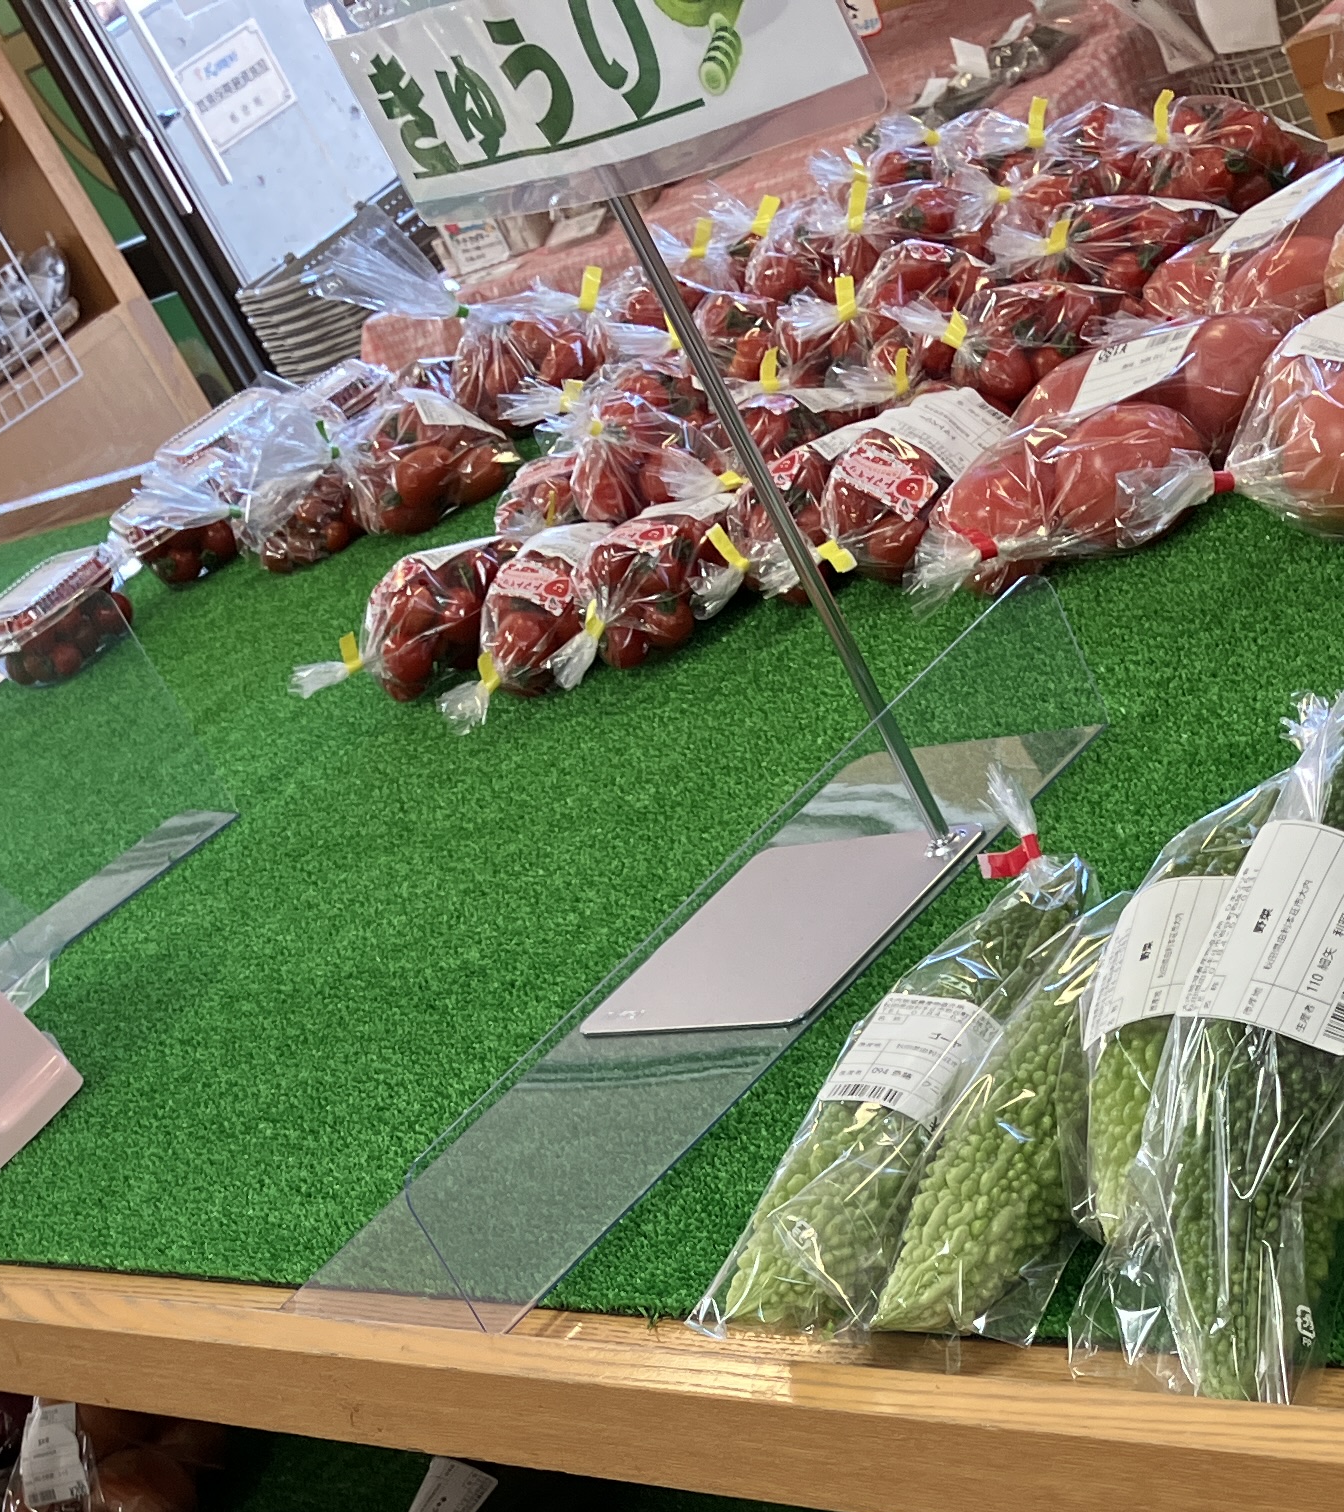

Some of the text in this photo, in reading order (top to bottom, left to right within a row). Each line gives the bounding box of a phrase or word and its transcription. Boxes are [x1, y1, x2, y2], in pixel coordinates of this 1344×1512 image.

[368, 0, 661, 174] きゅうり
[1252, 905, 1274, 936] 野菜
[1306, 971, 1324, 994] 110
